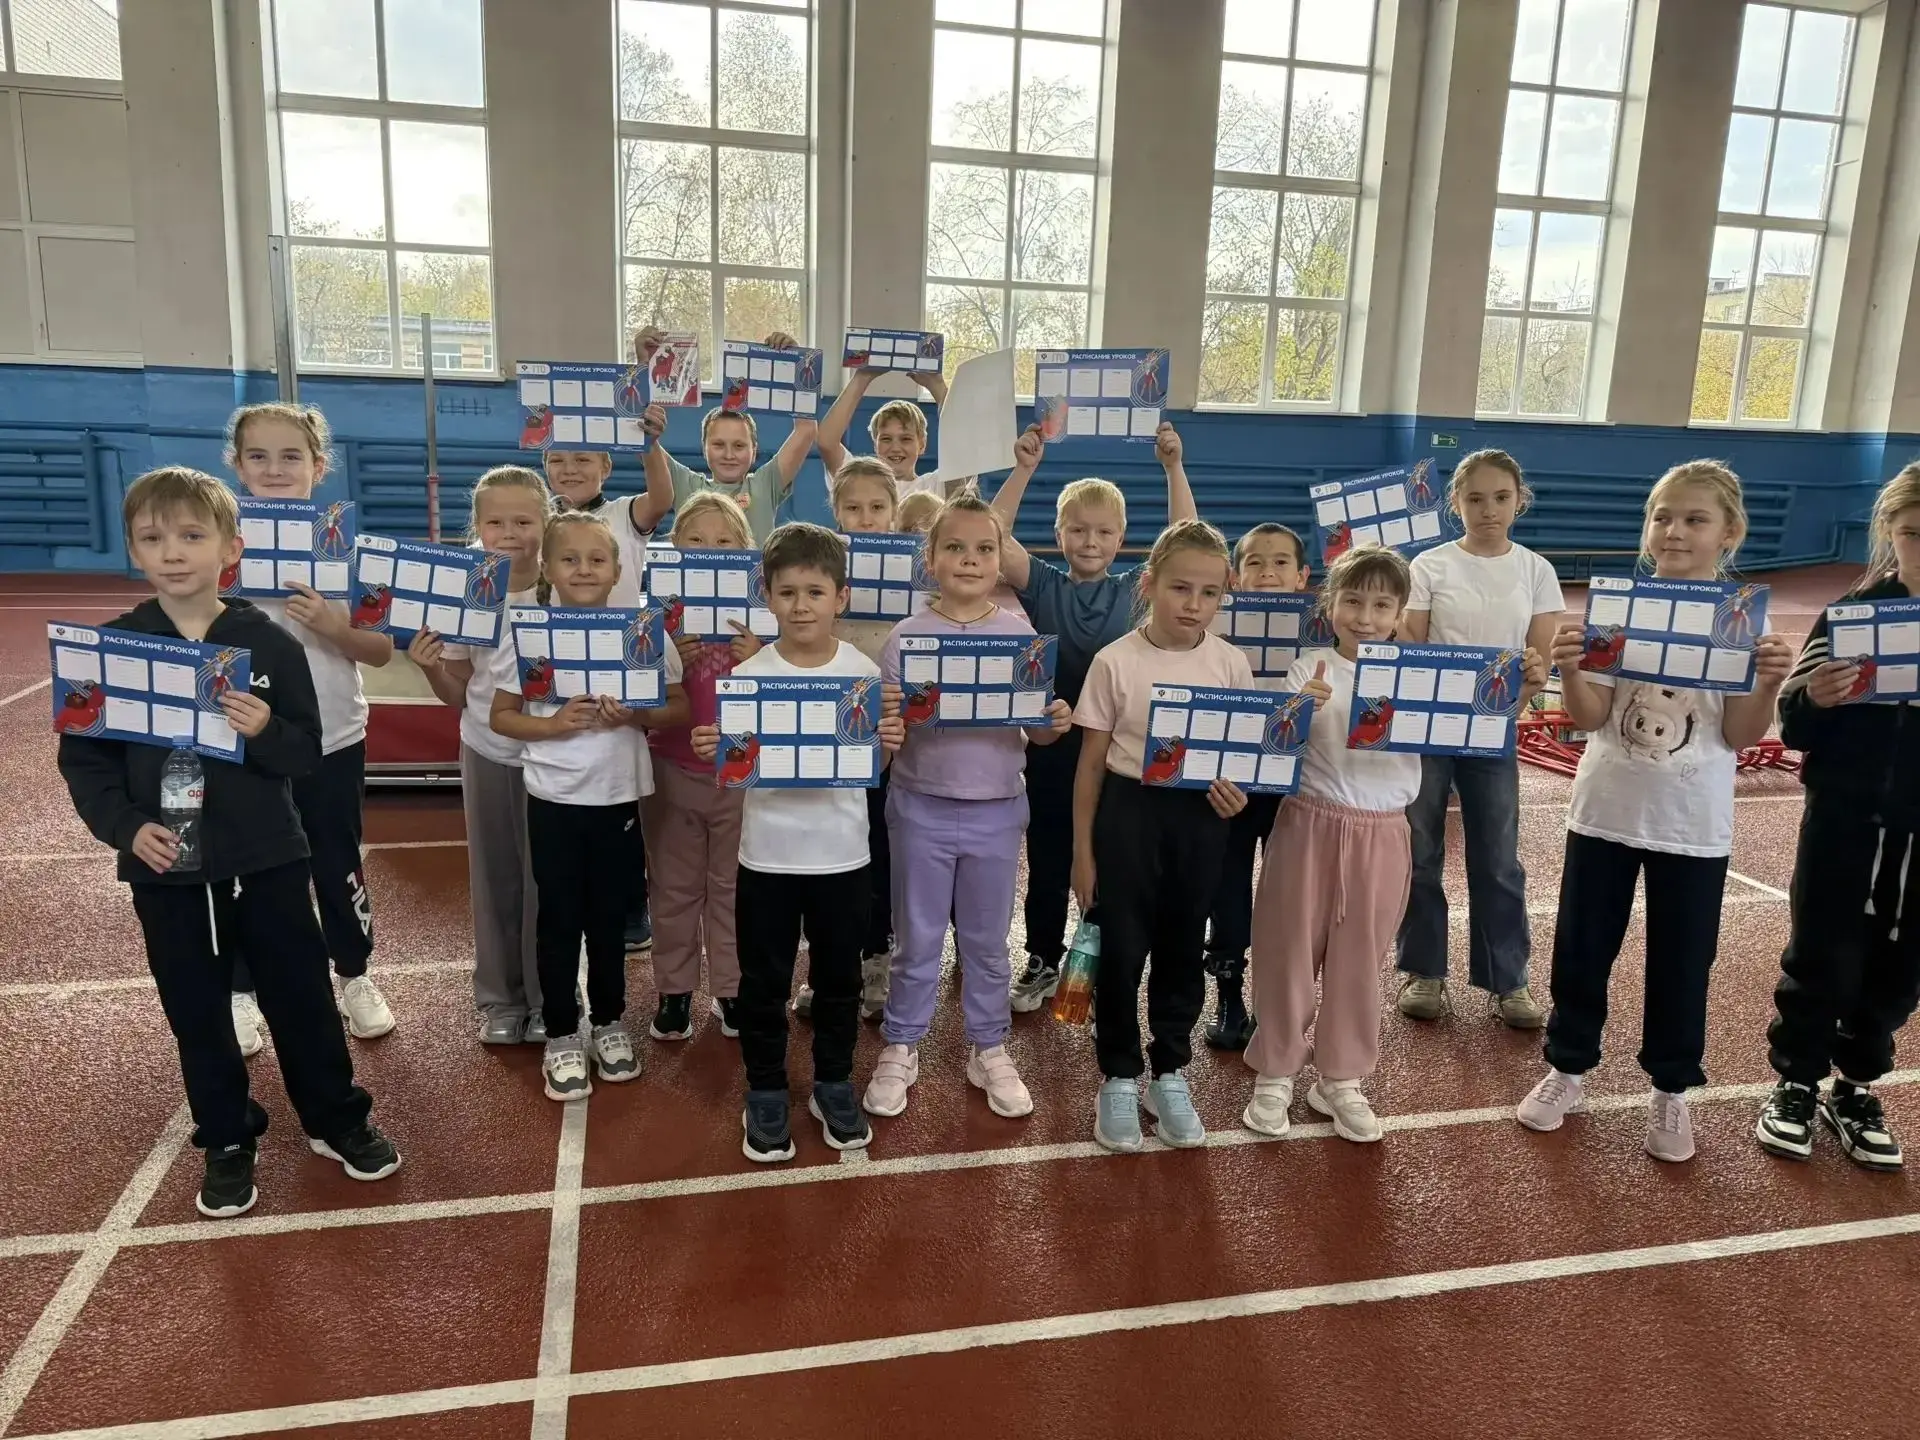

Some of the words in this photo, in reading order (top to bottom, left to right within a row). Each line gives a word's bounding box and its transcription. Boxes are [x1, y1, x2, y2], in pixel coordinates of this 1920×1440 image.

[552, 366, 592, 374] РАСПИСАНИЕ
[593, 366, 617, 374] УРОКОВ
[240, 501, 286, 511] РАСПИСАНИЕ
[288, 504, 316, 512] УРОКОВ
[853, 537, 892, 545] РАСПИСАНИЕ
[400, 543, 445, 557] РАСПИСАНИЕ
[446, 551, 474, 561] УРОКОВ
[684, 553, 725, 561] РАСПИСАНИЕ
[1636, 581, 1689, 592] РАСПИСАНИЕ
[1690, 584, 1723, 593] УРОКОВ
[551, 612, 597, 620] РАСПИСАНИЕ
[103, 635, 163, 651] РАСПИСАНИЕ
[164, 644, 201, 657] УРОКОВ
[1403, 648, 1452, 658] РАСПИСАНИЕ
[1453, 651, 1484, 660] УРОКОВ
[250, 671, 271, 689] LA
[761, 682, 810, 690] РАСПИСАНИЕ
[811, 683, 841, 691] УРОКОВ
[1195, 692, 1242, 702] РАСПИСАНИЕ
[1244, 695, 1274, 704] УРОКОВ
